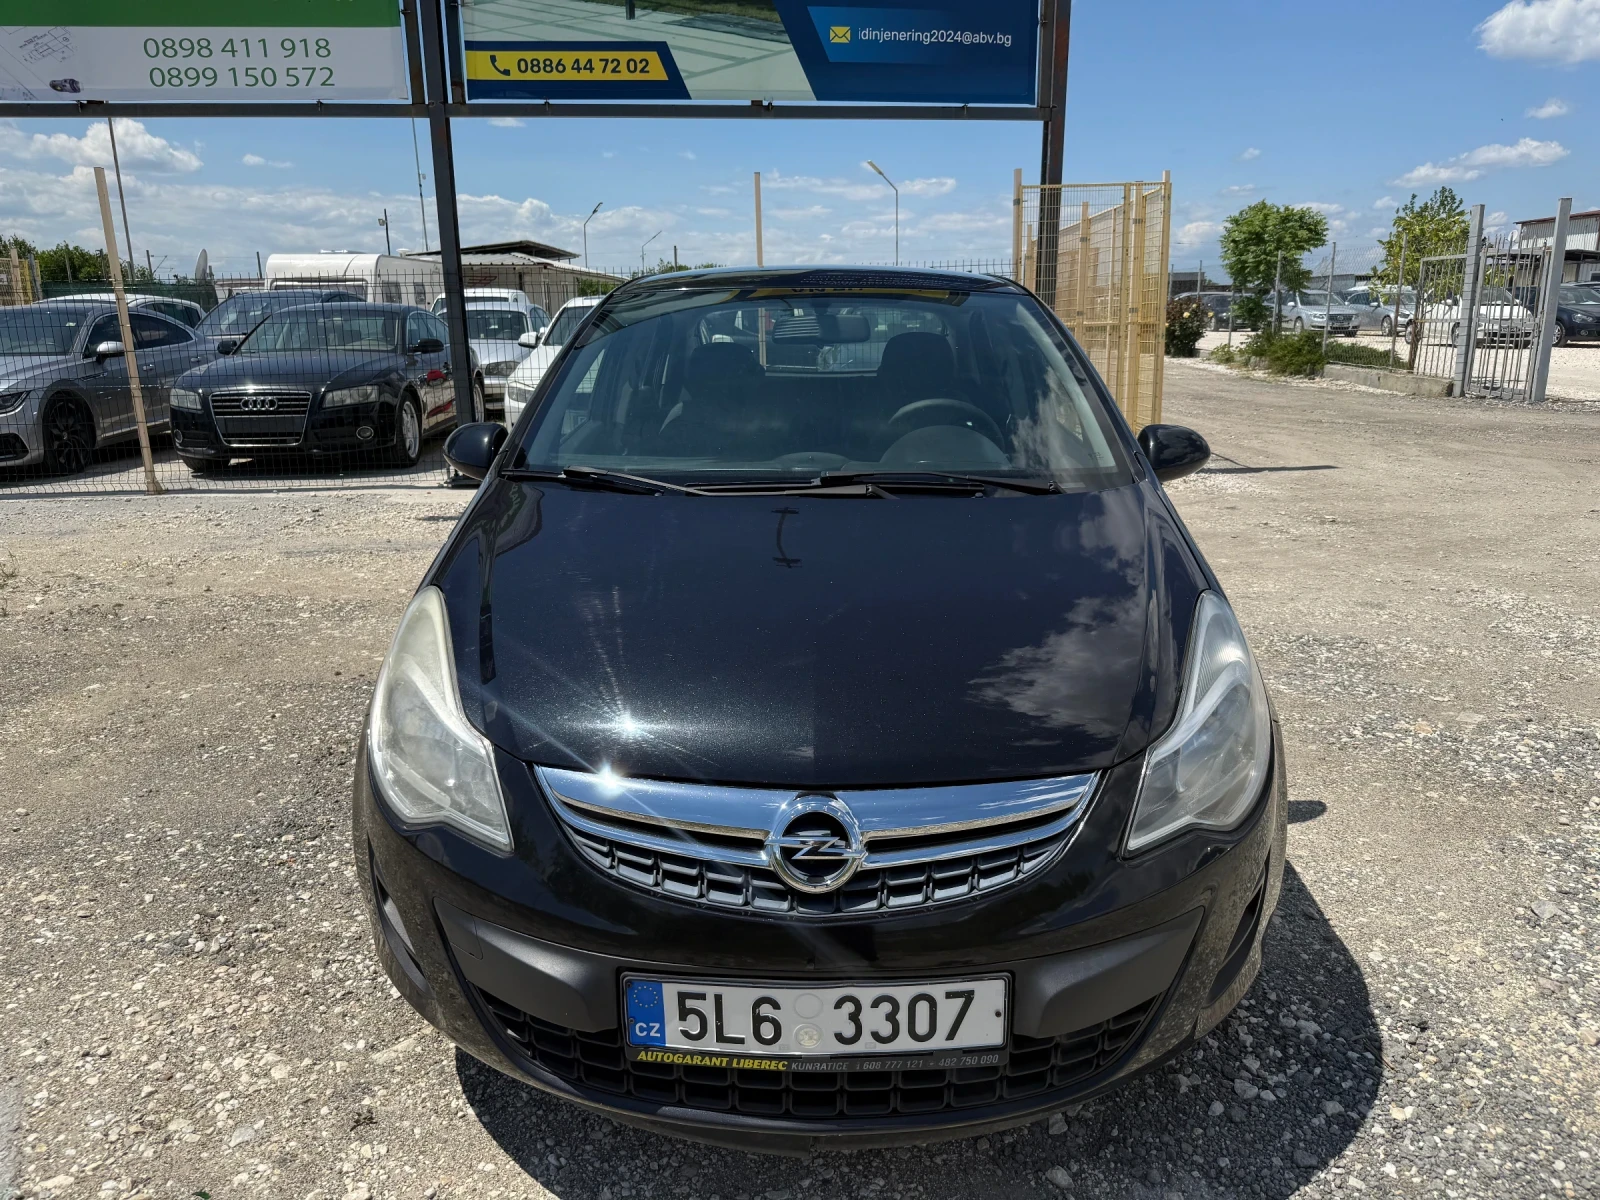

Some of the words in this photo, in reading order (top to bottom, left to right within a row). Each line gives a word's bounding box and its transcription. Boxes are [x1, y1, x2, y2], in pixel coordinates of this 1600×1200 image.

[858, 27, 1012, 47] idinjenering2024@abv.bg
[143, 37, 213, 58] 0898
[220, 38, 269, 58] 411
[280, 38, 331, 58] 918
[517, 58, 566, 74] 0886
[571, 58, 595, 74] 44
[599, 58, 621, 74] 72
[626, 58, 650, 74] 02
[149, 67, 218, 88] 0899
[228, 67, 278, 87] 150
[285, 67, 335, 87] 572
[677, 991, 783, 1046] 5L6
[833, 989, 976, 1045] 3307
[635, 1022, 661, 1038] CZ
[637, 1051, 730, 1067] AUTOGARANT
[732, 1058, 788, 1071] LIBEREC
[791, 1062, 848, 1071] KUNRATICE
[863, 1060, 882, 1070] 608
[885, 1059, 903, 1069] 777
[906, 1058, 924, 1068] 121
[938, 1057, 957, 1067] 482
[960, 1055, 978, 1066] 750
[980, 1054, 999, 1064] 090
